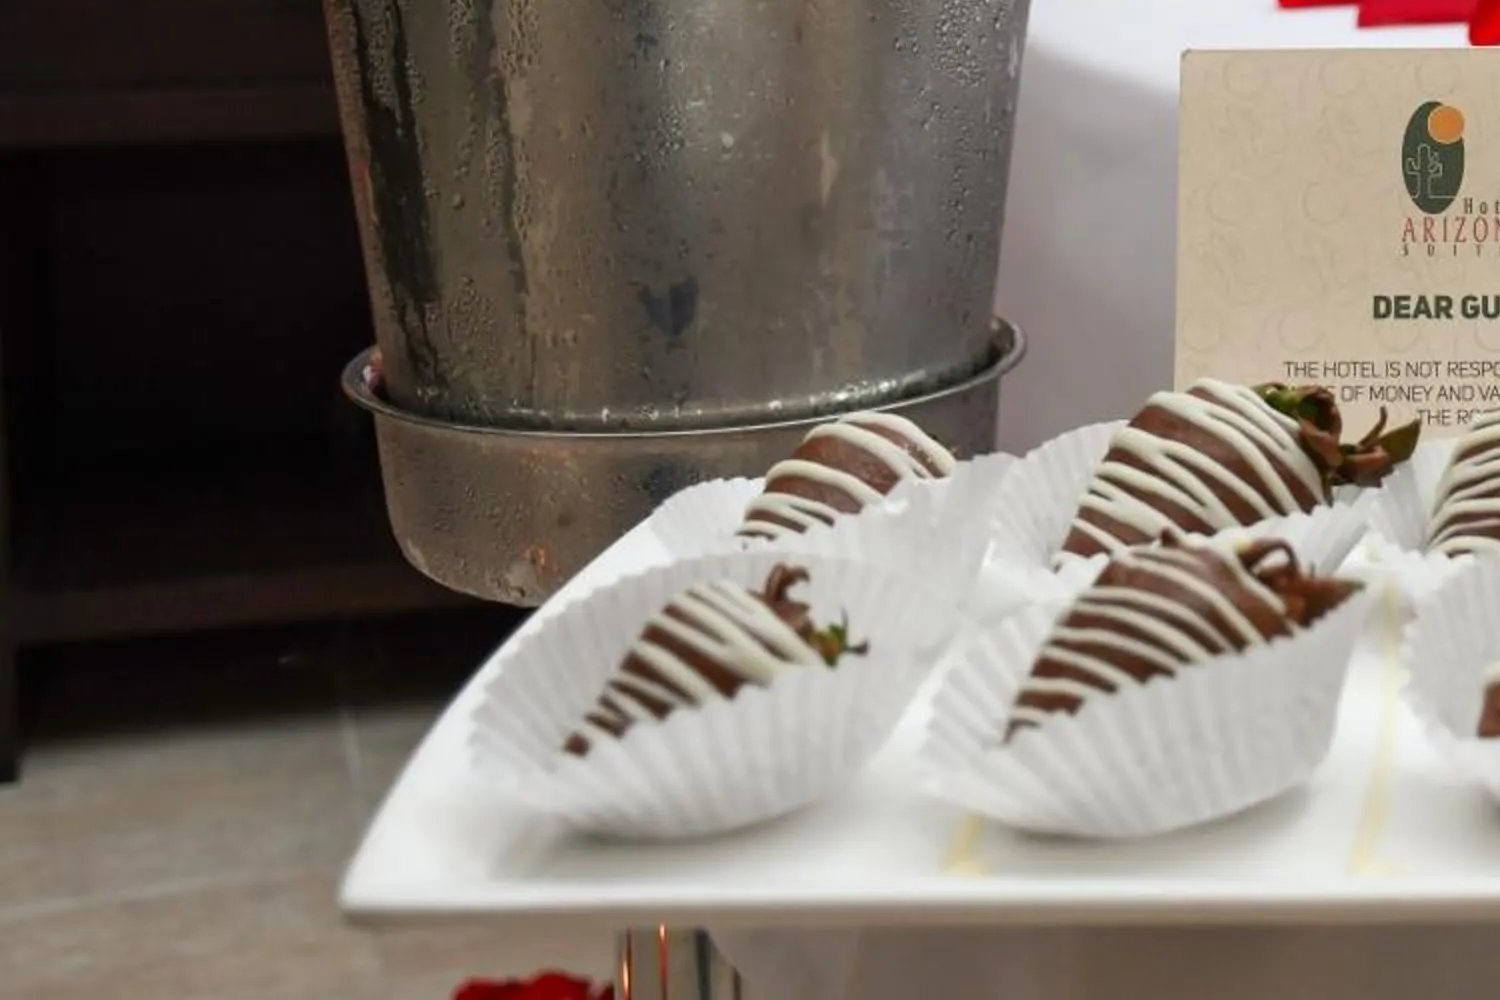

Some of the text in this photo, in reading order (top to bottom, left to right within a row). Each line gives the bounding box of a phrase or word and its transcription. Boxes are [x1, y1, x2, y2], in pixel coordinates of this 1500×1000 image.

[1373, 295, 1454, 319] DEAR
[1284, 361, 1319, 378] THE
[1323, 361, 1381, 378] HOTEL
[1386, 361, 1401, 378] IS
[1405, 361, 1442, 378] NOT
[1341, 385, 1365, 402] OF
[1369, 385, 1433, 402] MONEY
[1437, 385, 1475, 402] AND
[1417, 409, 1451, 426] THE
